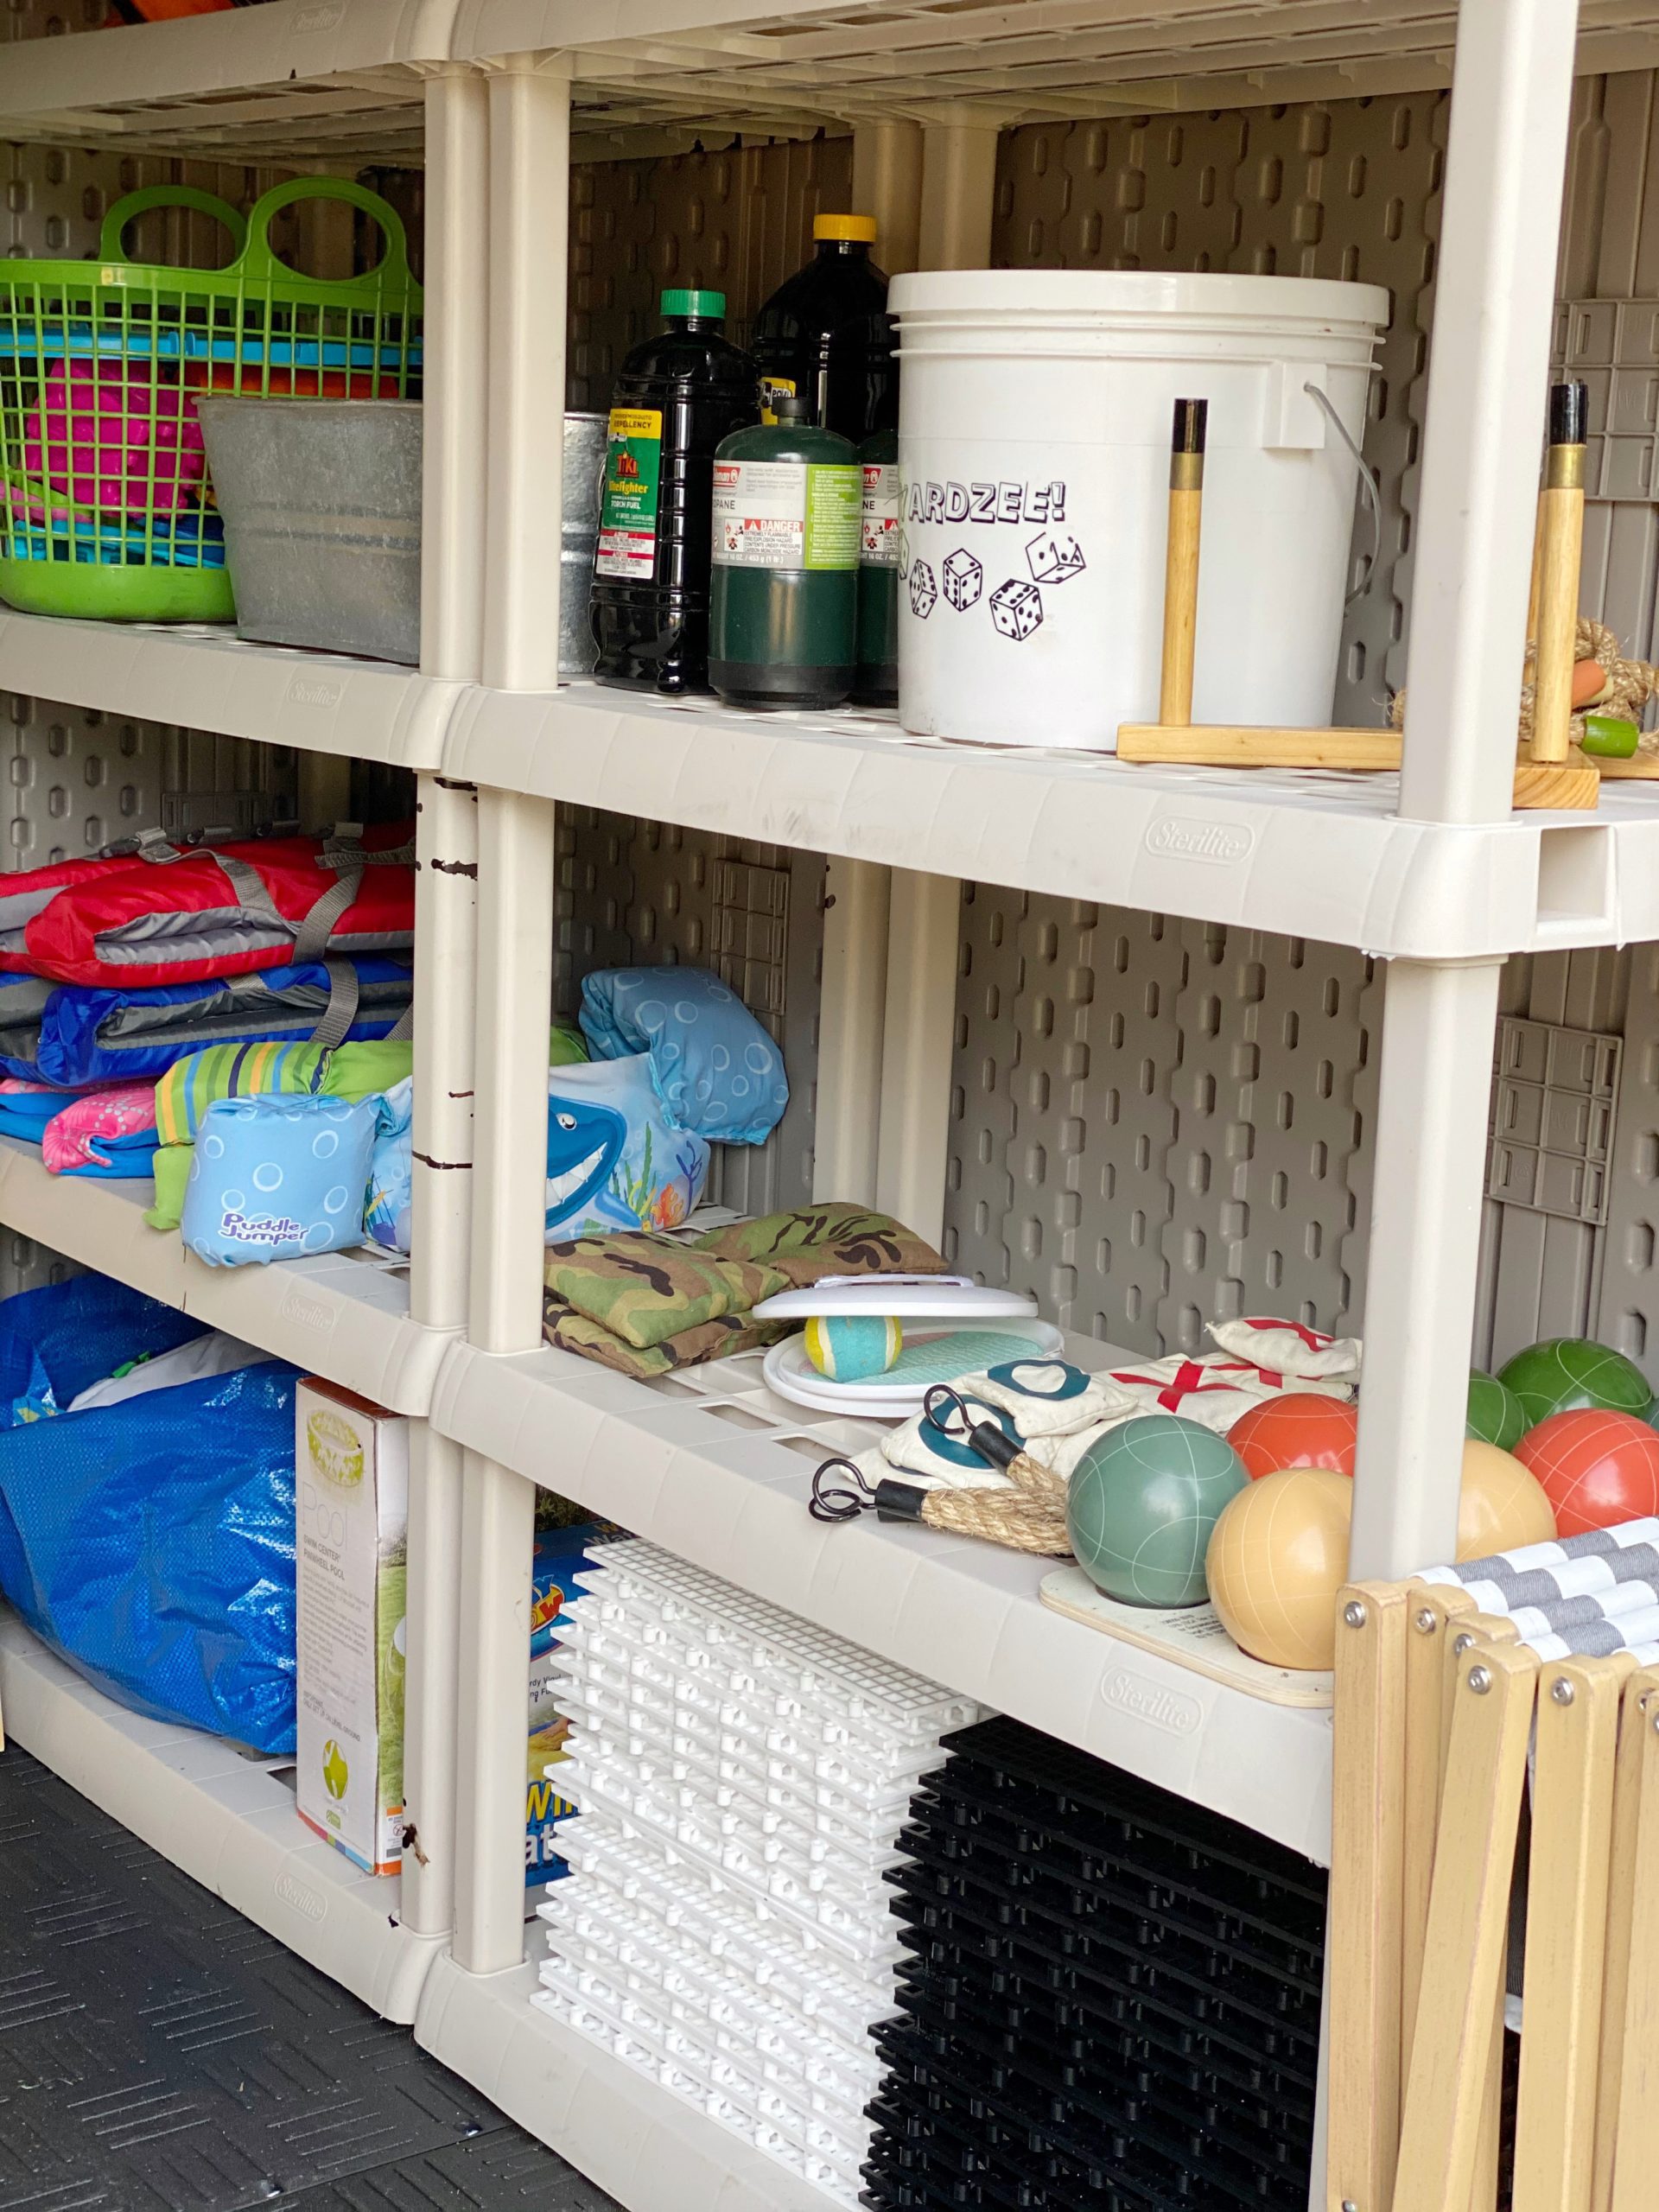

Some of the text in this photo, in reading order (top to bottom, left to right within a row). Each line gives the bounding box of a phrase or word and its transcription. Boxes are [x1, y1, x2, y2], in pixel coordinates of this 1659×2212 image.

[626, 502, 642, 511] FUEL
[760, 519, 800, 532] DANGER
[1154, 822, 1240, 858] Sterilite
[223, 1212, 300, 1233] Puddle
[220, 1224, 308, 1246] Jumper
[302, 1480, 348, 1552] Pool
[330, 1563, 346, 1581] POOL
[1109, 1675, 1189, 1729] Sterilite
